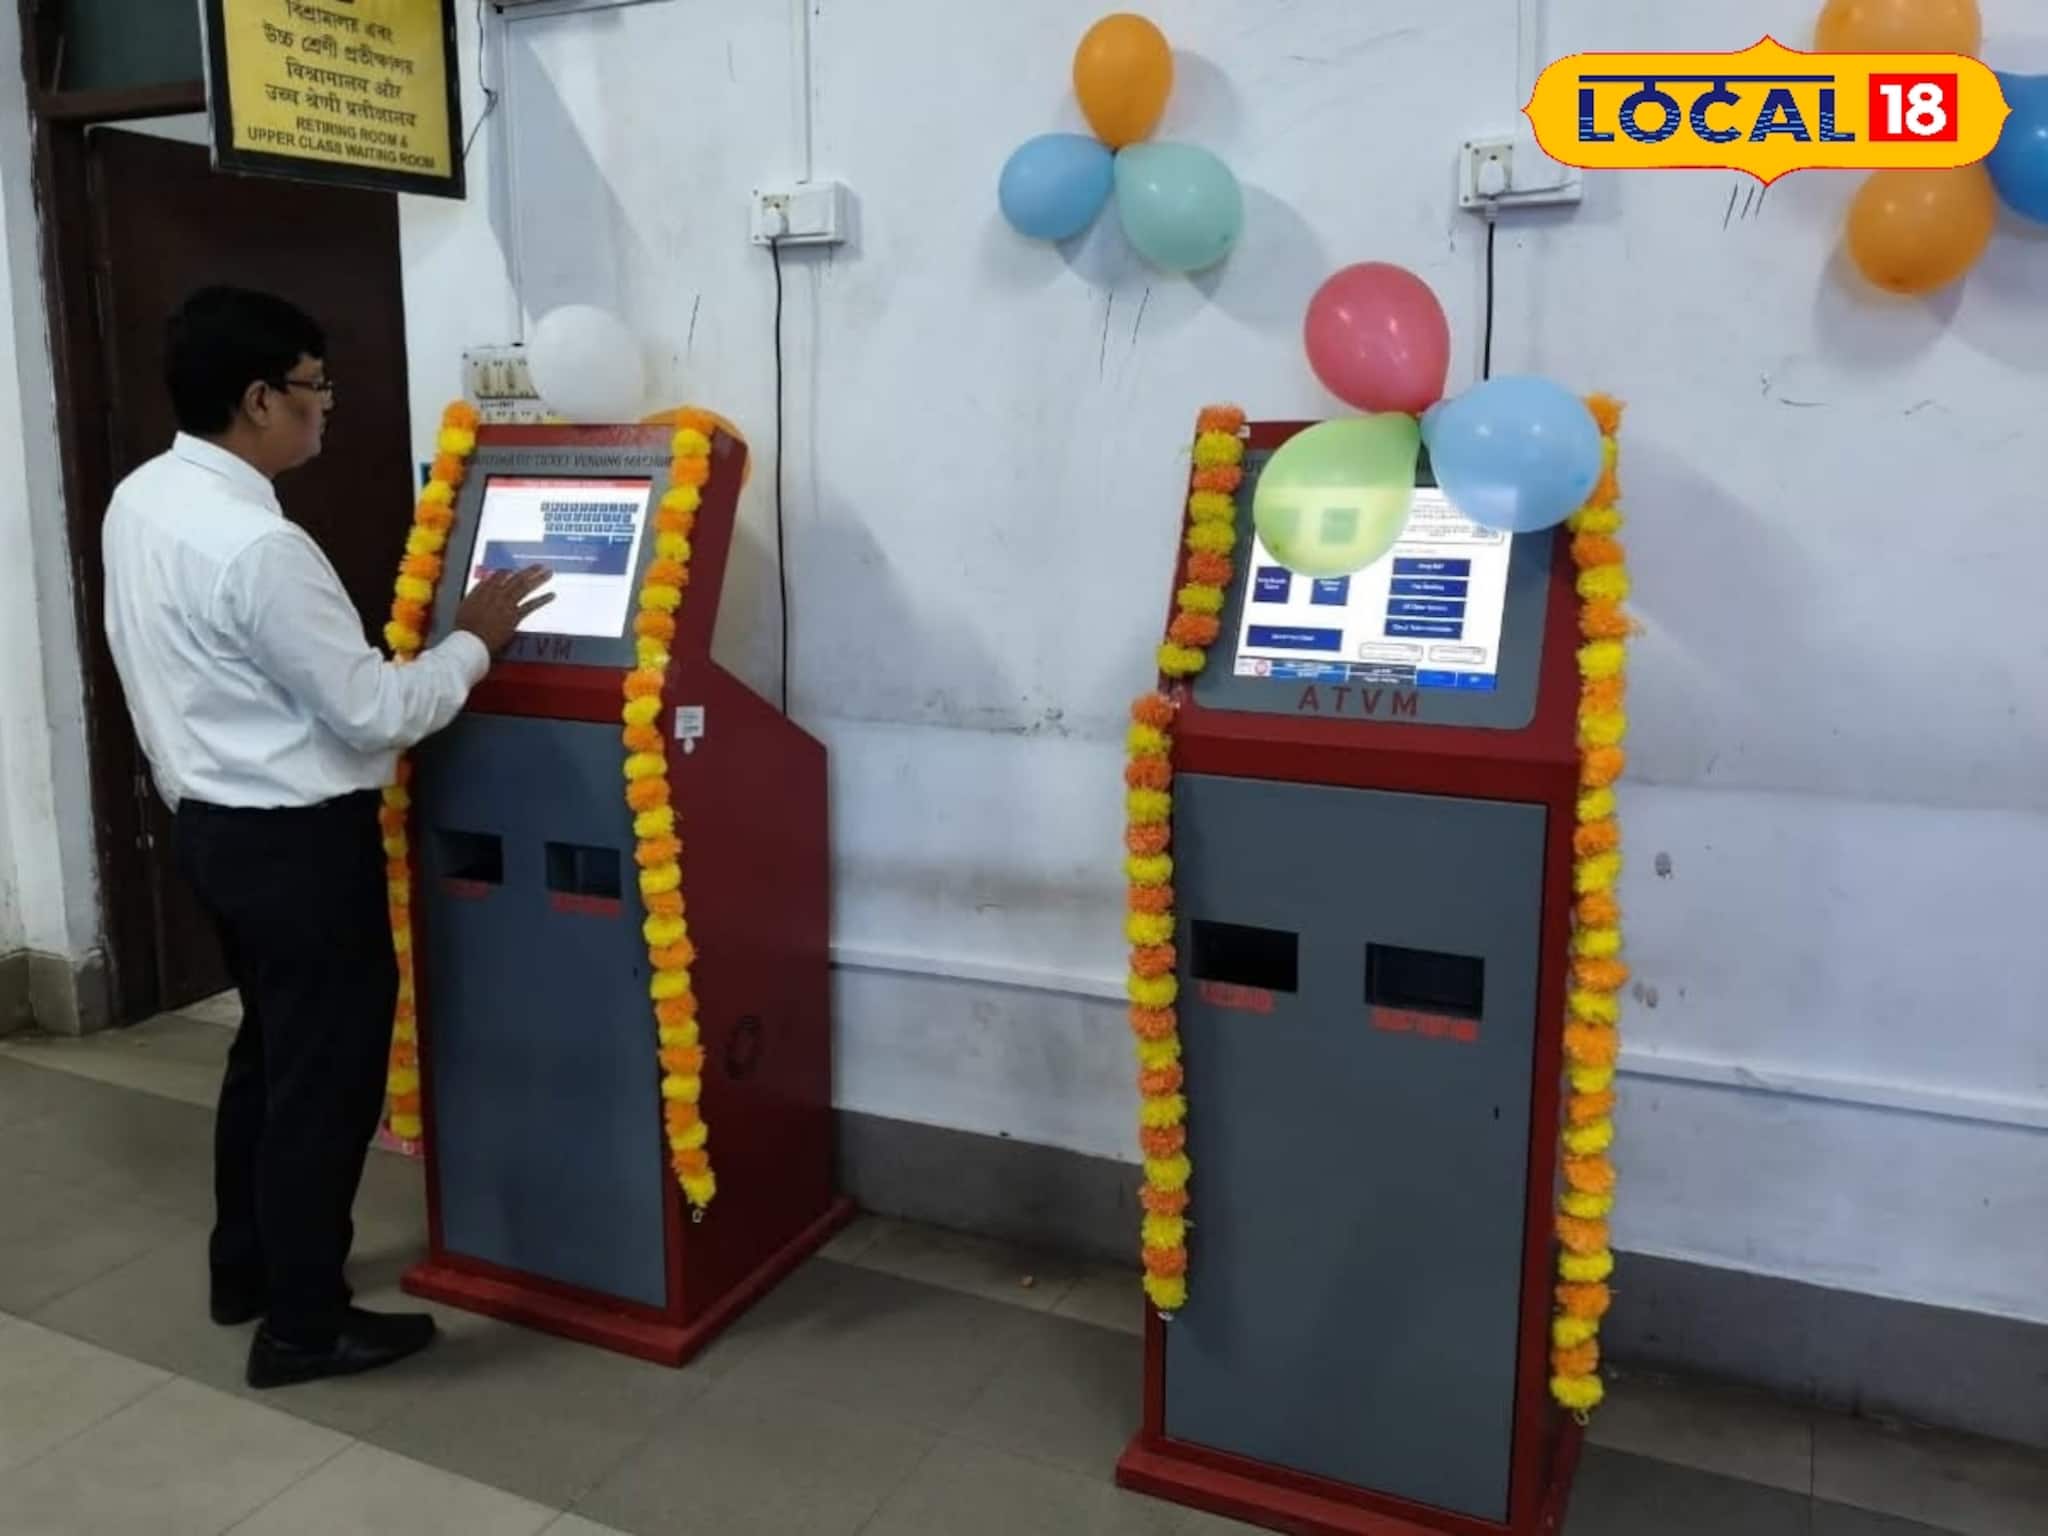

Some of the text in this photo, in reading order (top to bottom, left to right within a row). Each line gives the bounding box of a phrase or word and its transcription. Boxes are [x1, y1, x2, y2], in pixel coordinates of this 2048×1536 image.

[296, 116, 357, 139] RETIRING
[360, 126, 397, 146] ROOM
[248, 126, 435, 169] UPPER CLASS WAITING ROOM
[1298, 685, 1420, 716] ATVM
